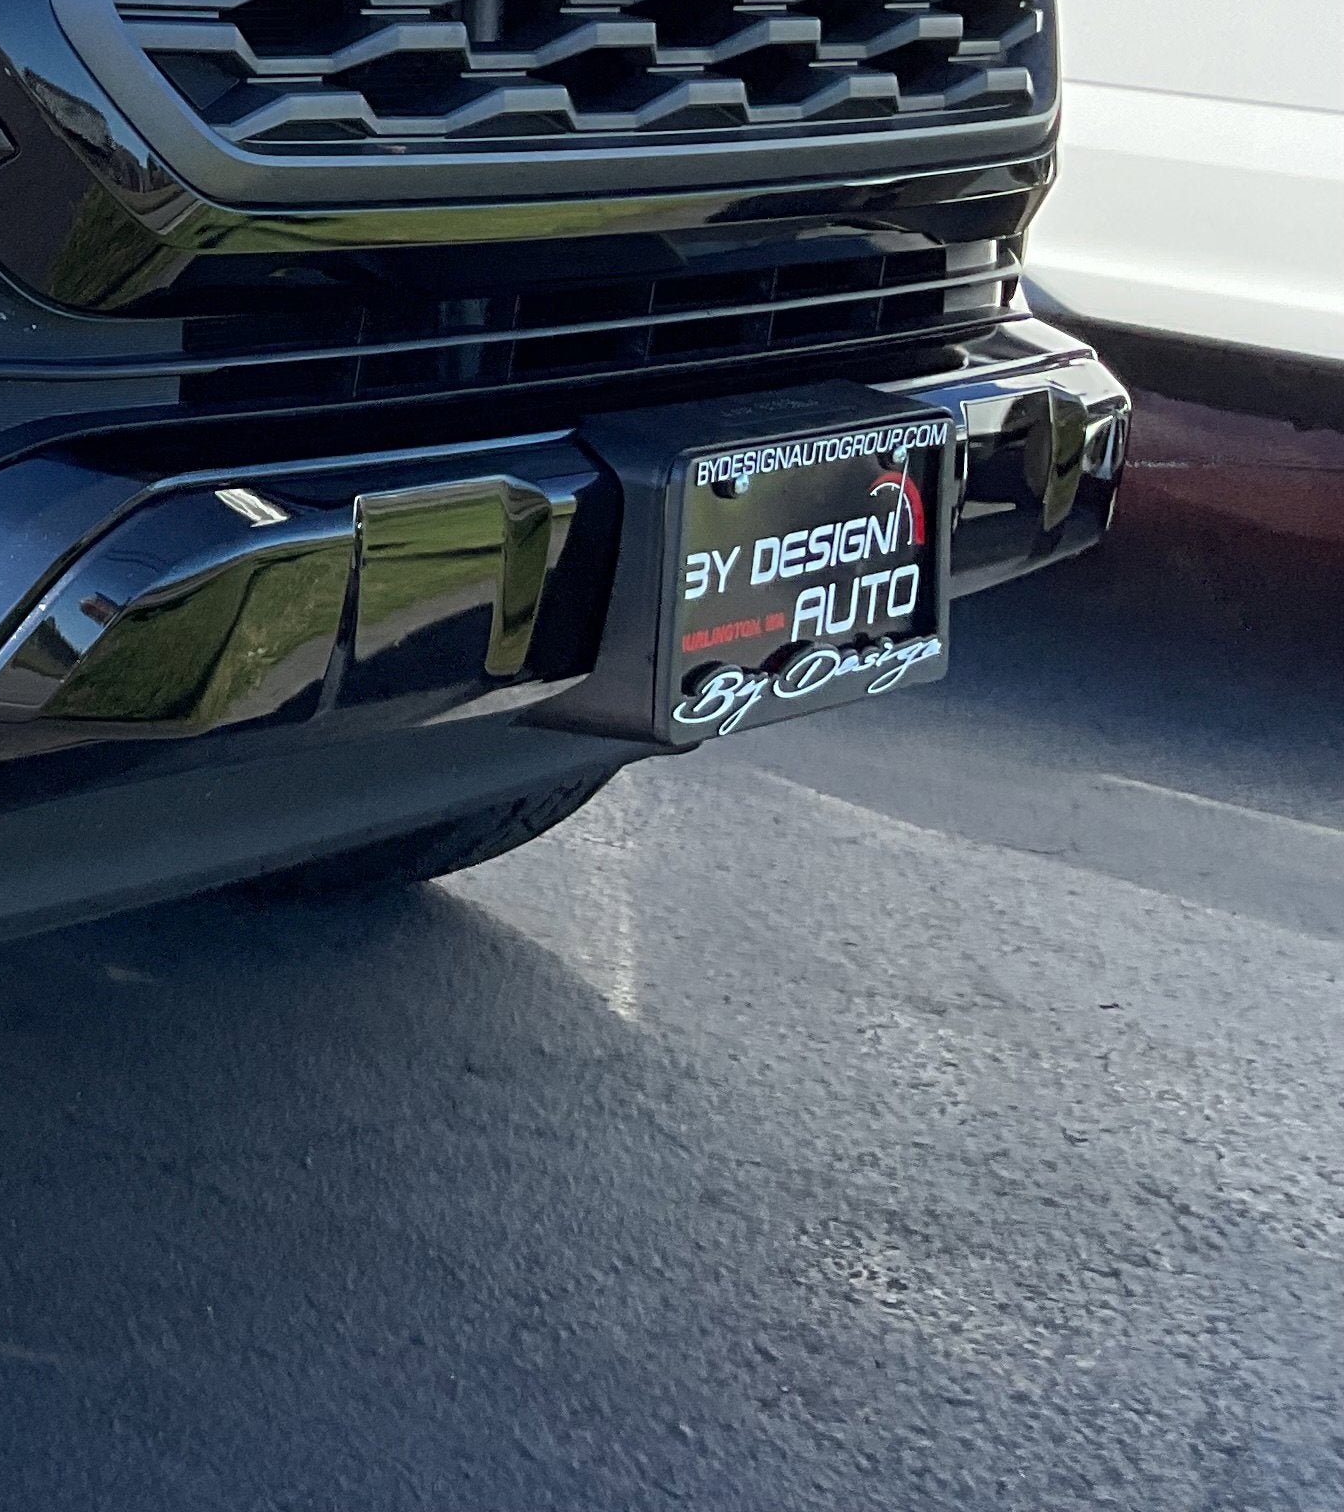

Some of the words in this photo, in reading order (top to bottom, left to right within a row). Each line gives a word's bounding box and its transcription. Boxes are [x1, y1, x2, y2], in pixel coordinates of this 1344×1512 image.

[684, 545, 741, 600] BY
[750, 511, 896, 585] DESIGN
[791, 563, 919, 642] AUTO
[672, 671, 769, 736] By
[773, 638, 942, 699] Design
